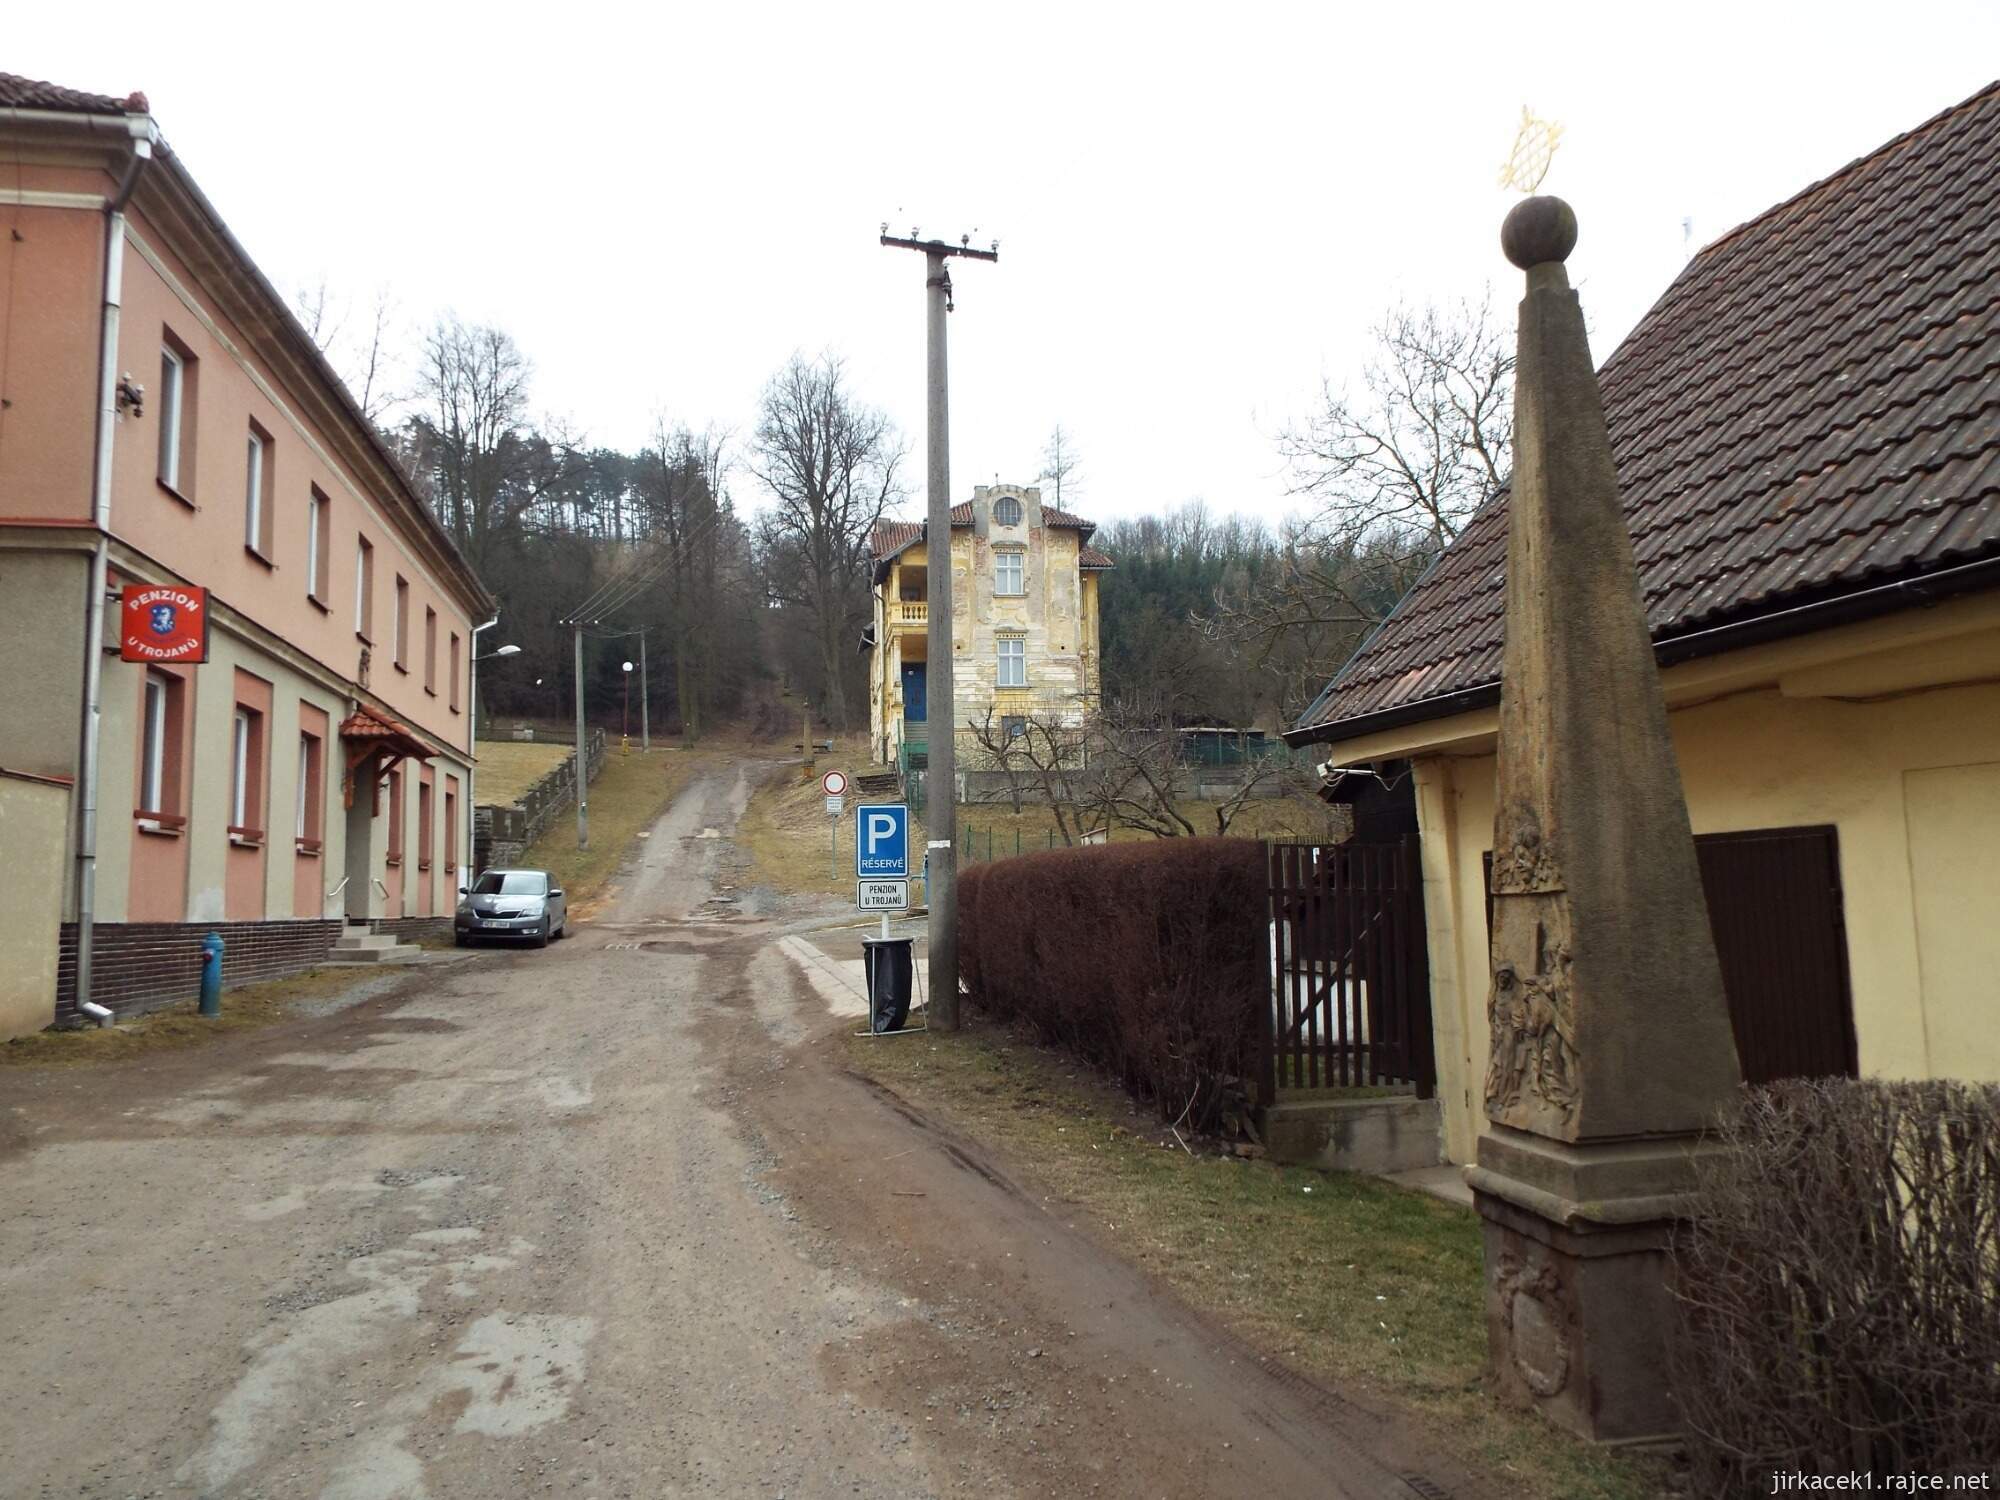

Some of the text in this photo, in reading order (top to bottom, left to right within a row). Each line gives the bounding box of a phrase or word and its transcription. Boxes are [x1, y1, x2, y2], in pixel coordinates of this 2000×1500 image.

[129, 590, 199, 612] PENZION
[127, 636, 139, 646] U
[868, 813, 897, 854] P
[861, 857, 904, 869] RÉSERVÉ
[869, 885, 897, 894] PENZION
[865, 895, 902, 905] U TROJANŮ
